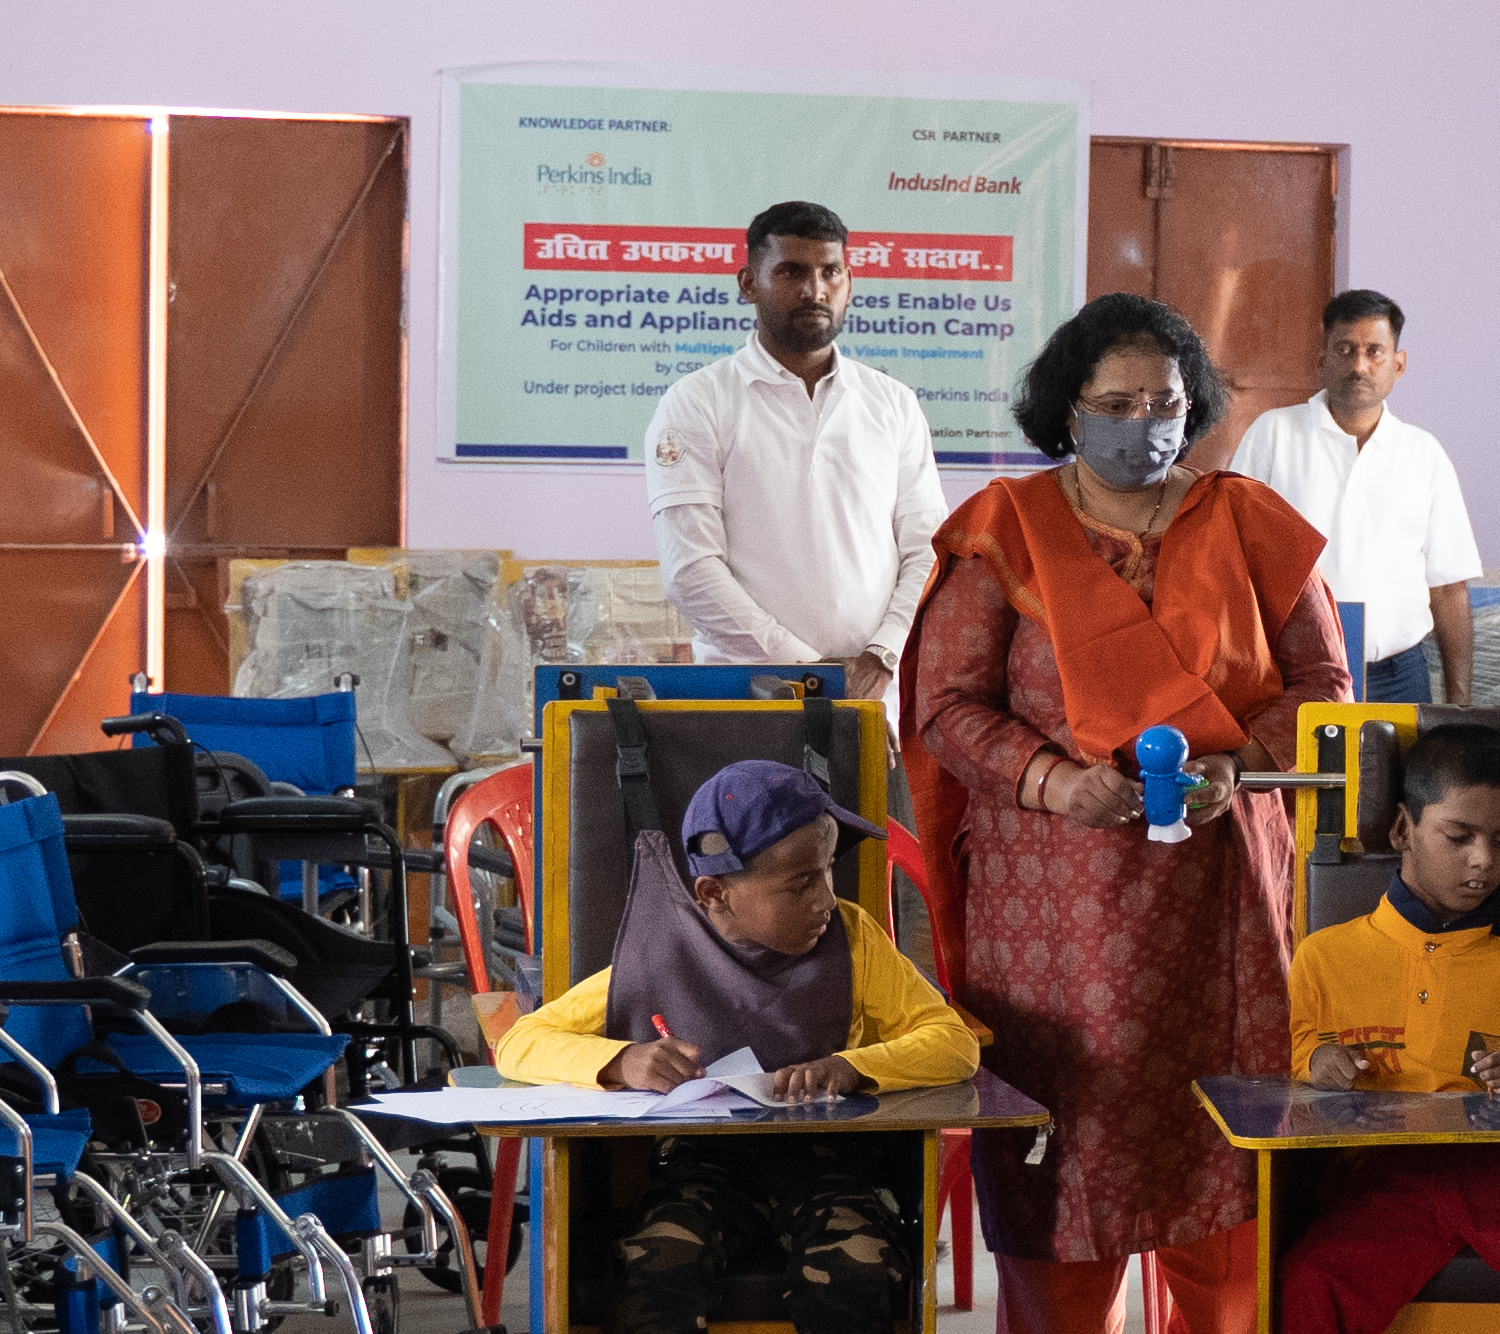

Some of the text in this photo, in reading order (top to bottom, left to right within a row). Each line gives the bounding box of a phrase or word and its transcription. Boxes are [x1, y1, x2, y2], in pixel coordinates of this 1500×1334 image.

[518, 117, 672, 132] KNOWLEDGE PARTNER:
[912, 130, 1001, 143] CSR PARTNER
[537, 163, 653, 186] Perkins India
[888, 172, 1022, 194] IndusInd Bank
[534, 233, 611, 260] उचित
[621, 241, 735, 264] उपकरण
[525, 283, 670, 306] Appropriate
[676, 285, 730, 306] Aids
[898, 292, 977, 311] Enable
[984, 295, 1012, 312] Us
[520, 308, 760, 334] Aids and Applianc
[944, 318, 1015, 341] Camp
[550, 339, 573, 352] For
[577, 339, 636, 353] Children
[640, 341, 671, 354] with
[675, 342, 734, 355] Multiple
[854, 345, 899, 358] Vision
[901, 346, 985, 359] Impairment
[655, 361, 672, 376] by
[523, 380, 570, 394] Under
[574, 381, 627, 398] project
[916, 387, 1010, 402] Perkins India
